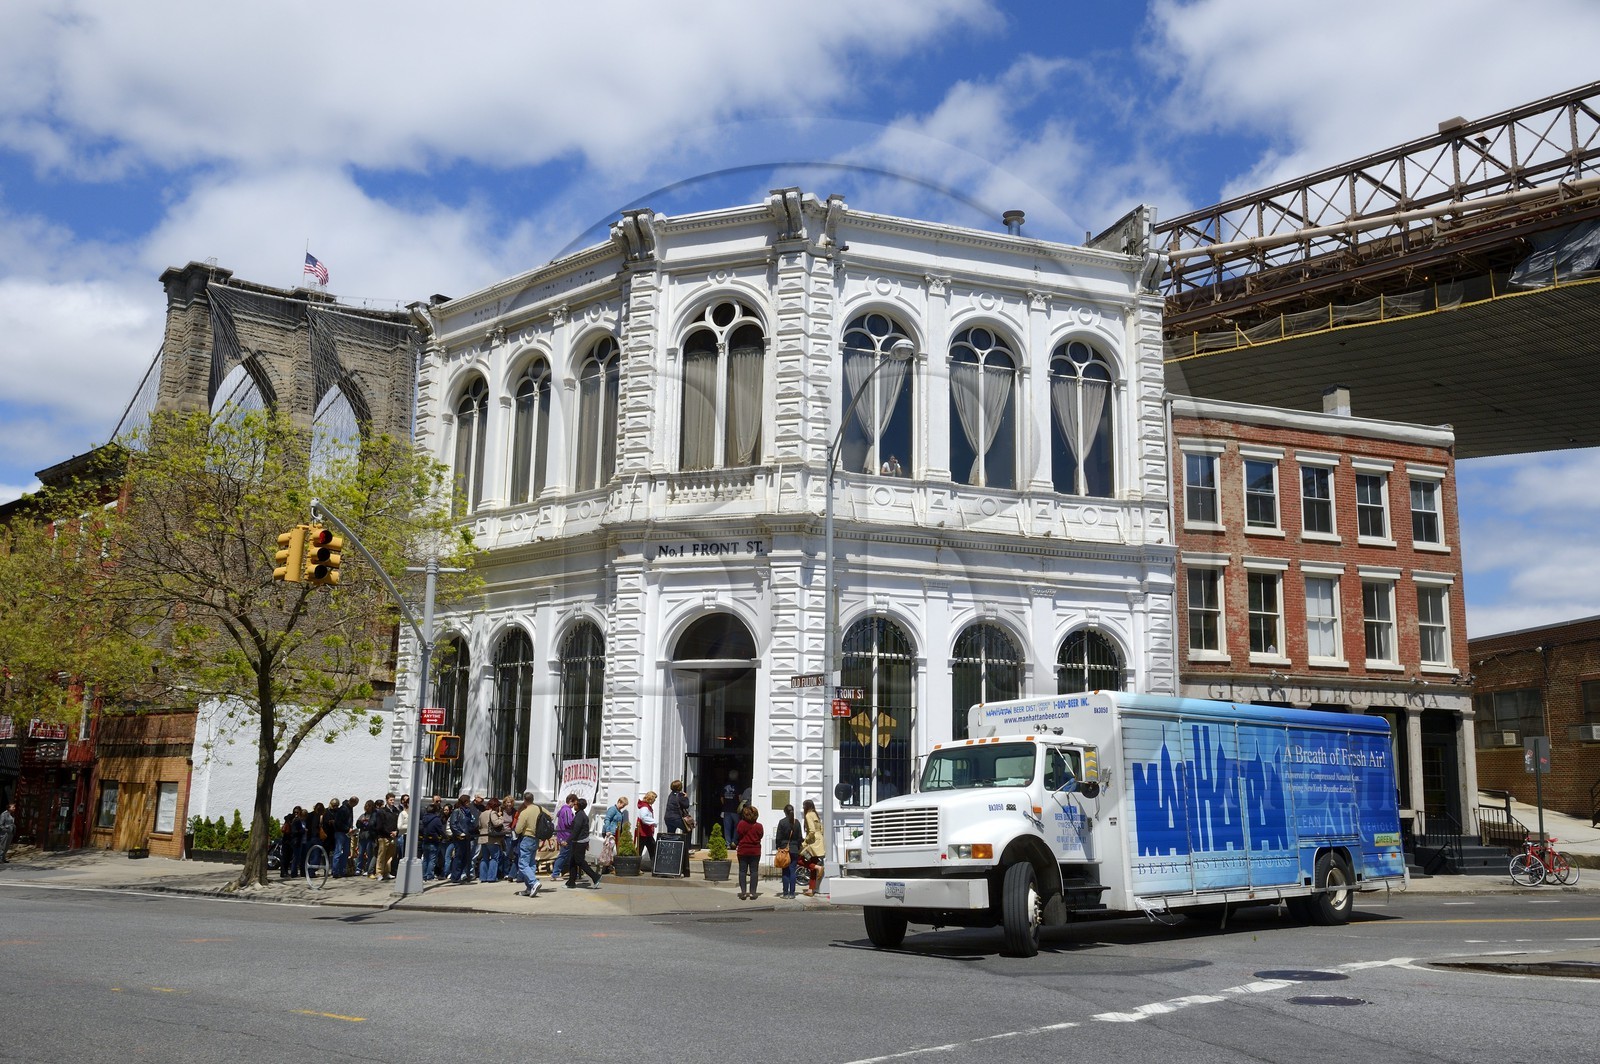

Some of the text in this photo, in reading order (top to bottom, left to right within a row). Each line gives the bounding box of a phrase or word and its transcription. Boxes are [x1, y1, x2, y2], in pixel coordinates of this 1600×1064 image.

[692, 542, 740, 556] FRONT
[746, 541, 763, 554] ST.
[792, 678, 800, 688] OLD
[802, 677, 817, 687] FULTON
[836, 689, 864, 699] FRONT ST
[1013, 706, 1025, 714] BEER
[1004, 712, 1069, 723] www.manhattanbeer.com
[1284, 746, 1293, 764] A
[1295, 745, 1328, 765] Breath
[1329, 748, 1340, 765] of
[1368, 751, 1387, 768] Air!
[1138, 861, 1180, 875] BEER
